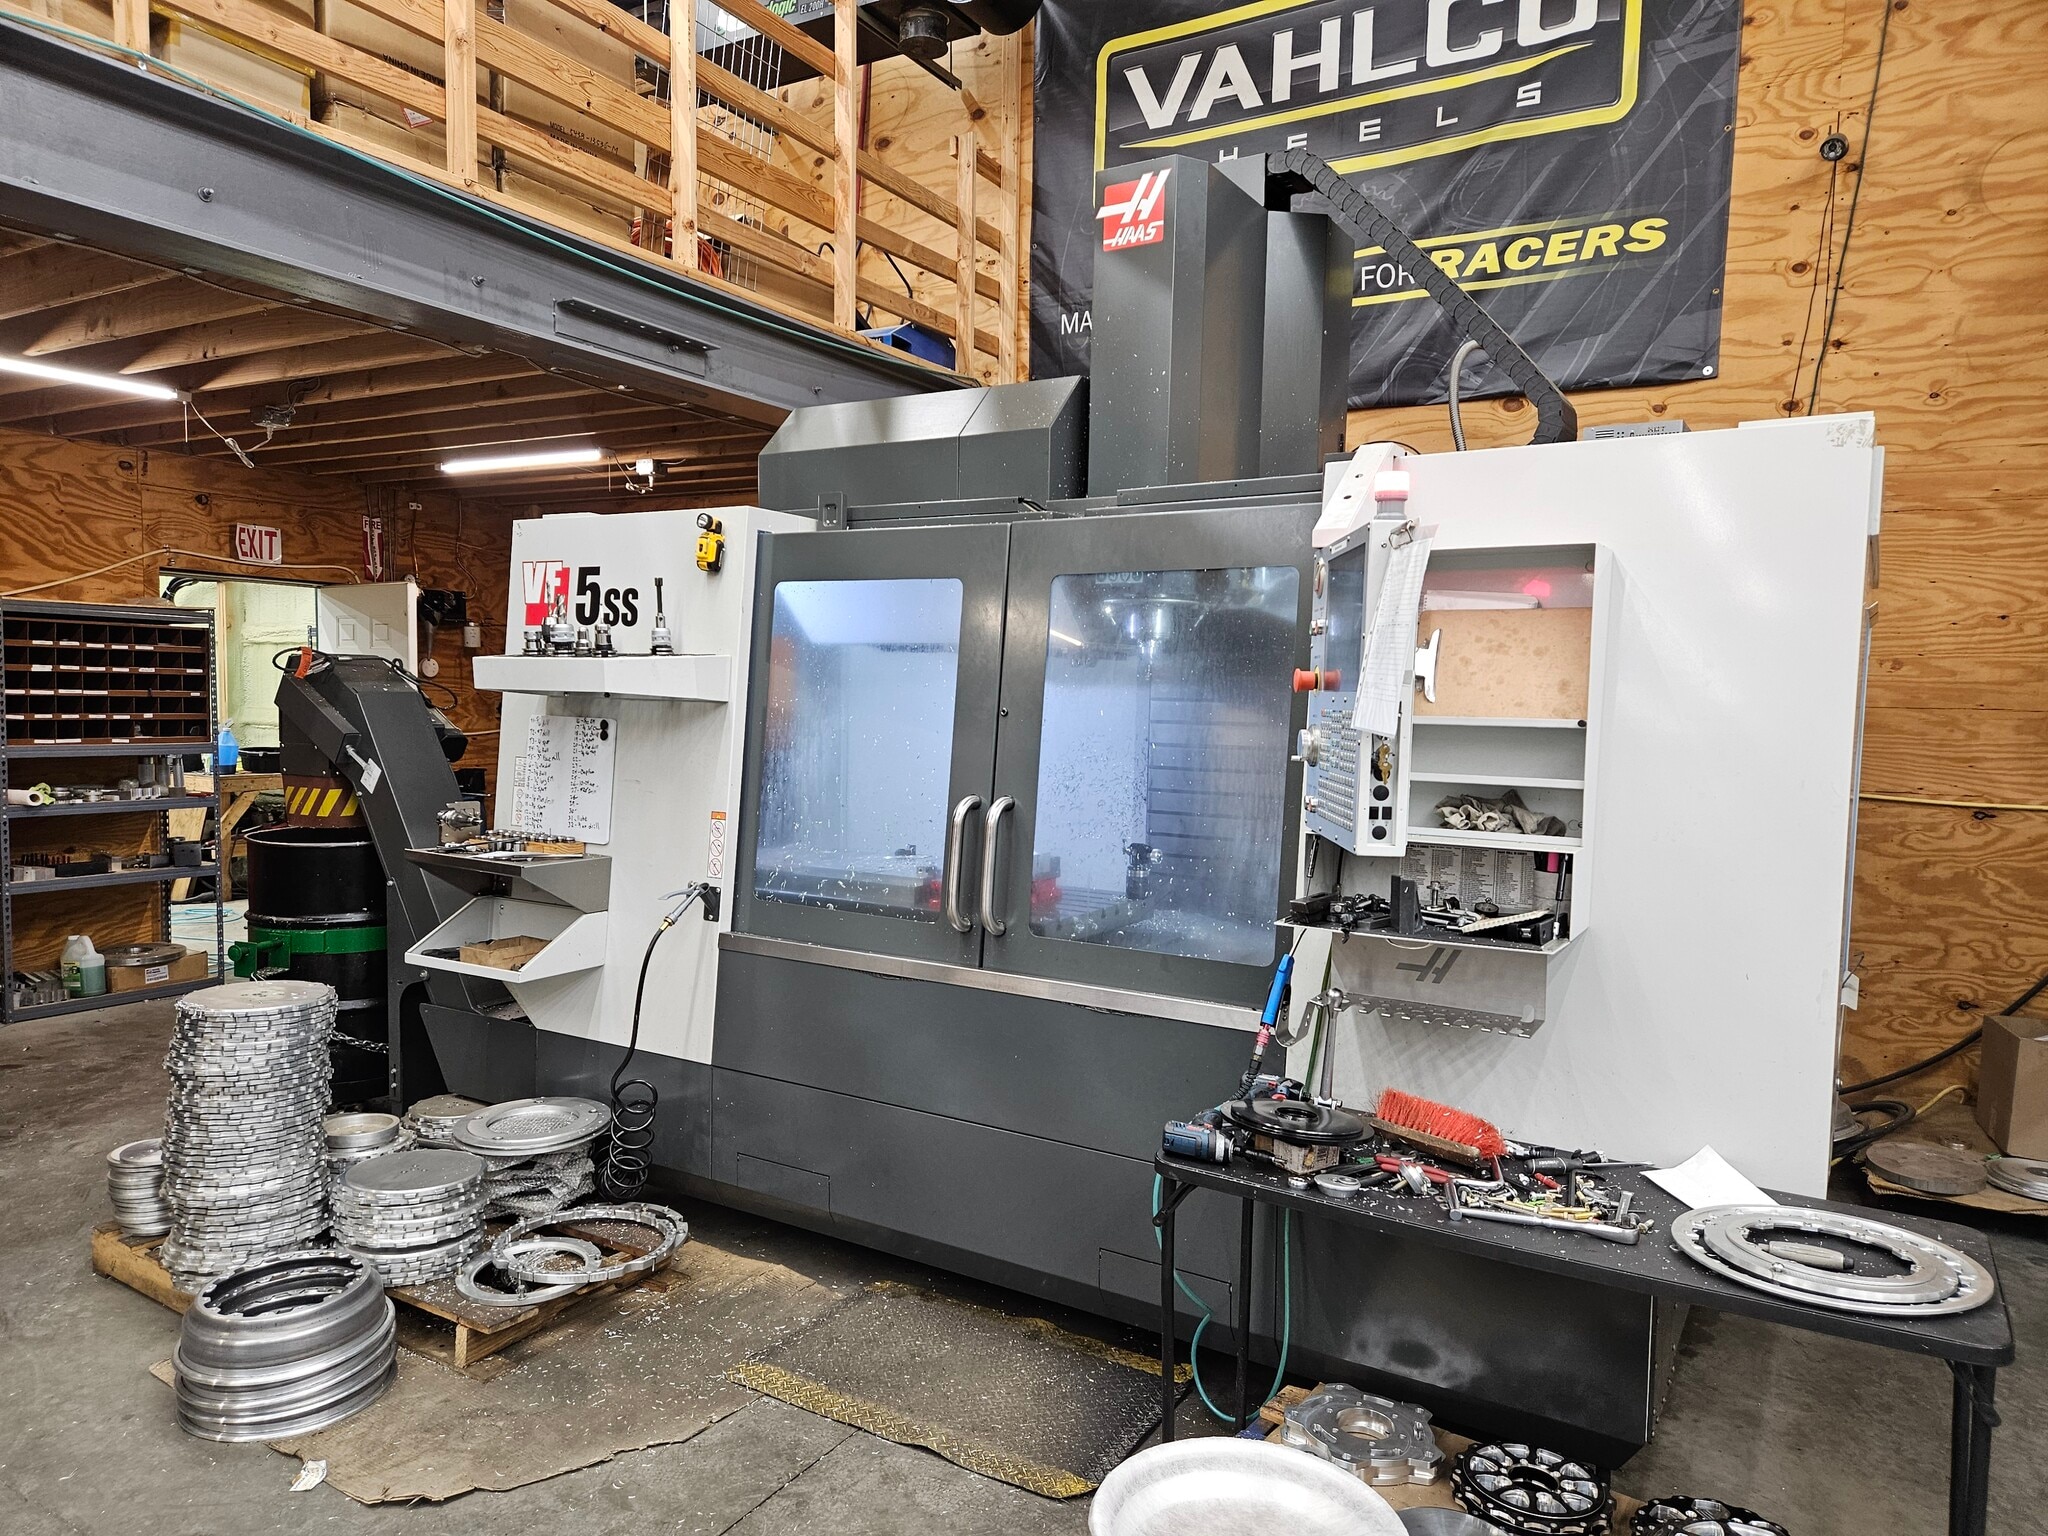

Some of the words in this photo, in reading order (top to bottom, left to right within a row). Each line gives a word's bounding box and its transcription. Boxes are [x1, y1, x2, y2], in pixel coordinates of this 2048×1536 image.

[766, 0, 797, 18] logic
[382, 53, 409, 72] CHINA
[1218, 81, 1542, 163] HEELS
[1104, 220, 1164, 247] HAAS
[1429, 217, 1670, 280] RACERS
[238, 526, 278, 561] EXIT
[522, 560, 564, 605] VF
